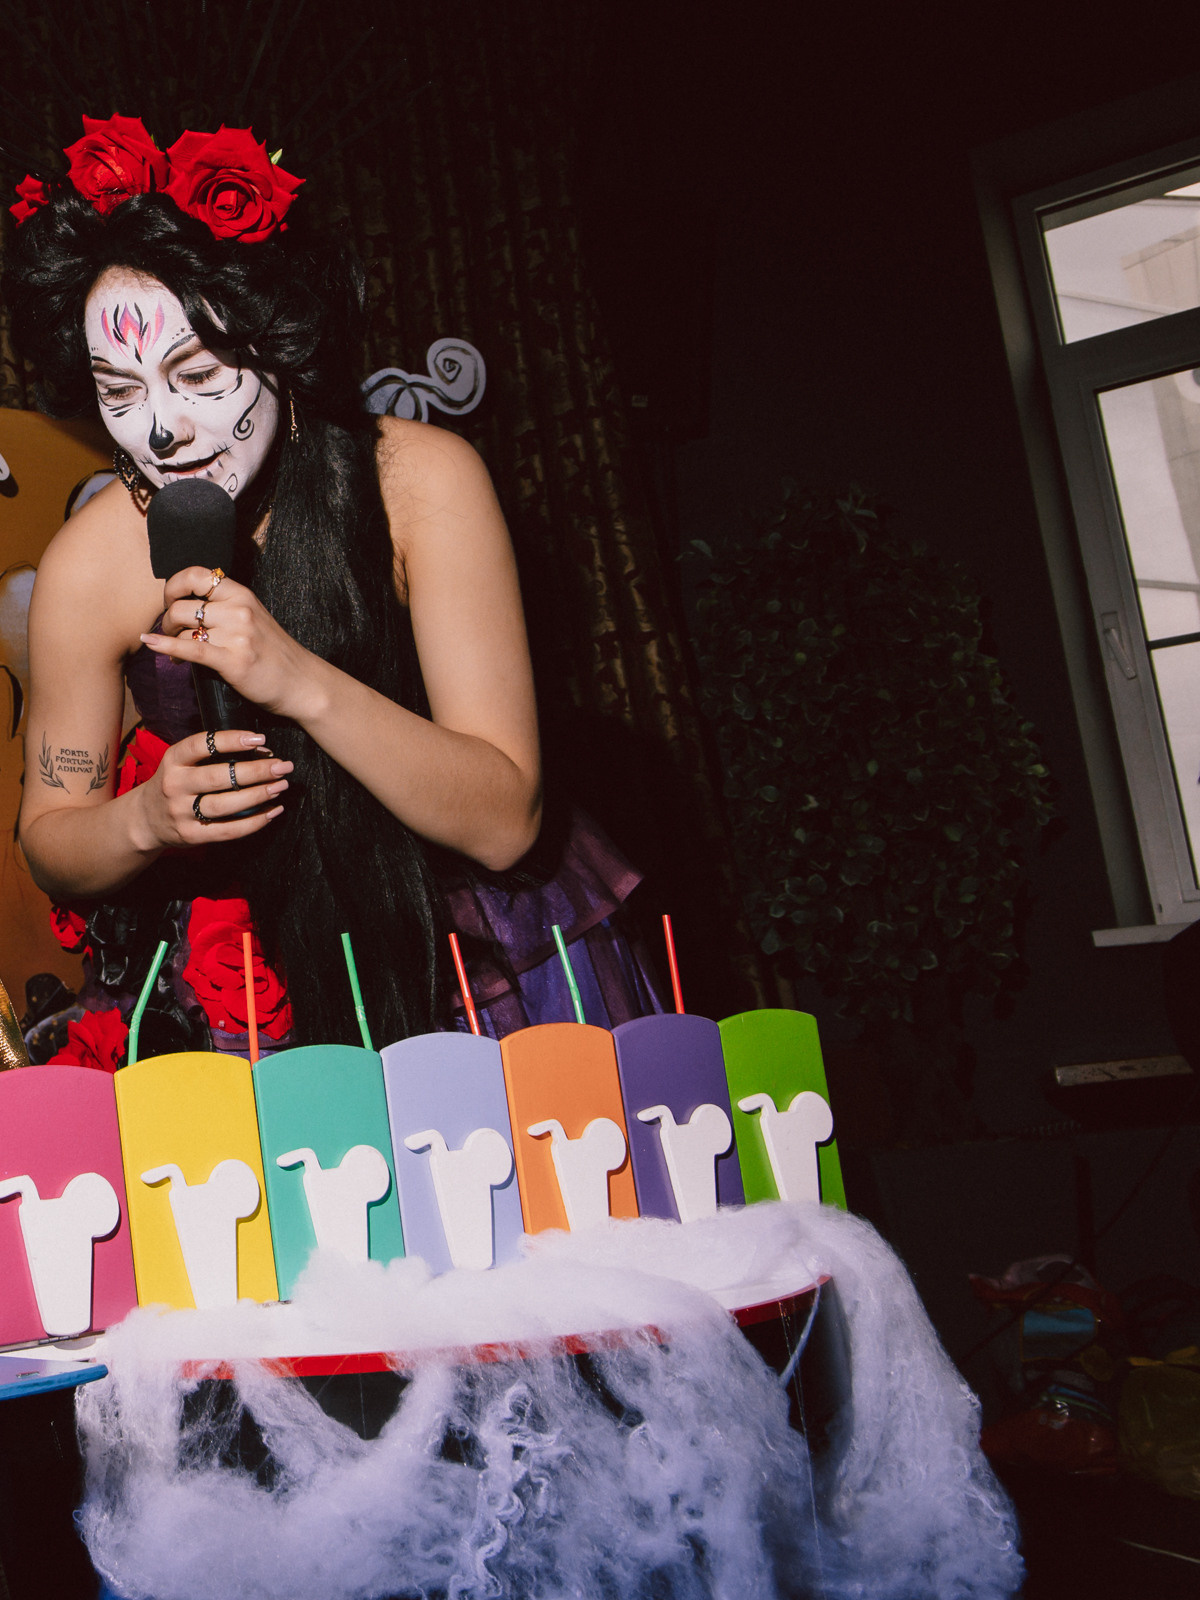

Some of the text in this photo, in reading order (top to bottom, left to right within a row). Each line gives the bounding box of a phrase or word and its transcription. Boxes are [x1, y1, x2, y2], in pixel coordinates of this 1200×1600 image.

[60, 748, 89, 758] FORTIS
[55, 755, 94, 765] FORTUNA
[57, 765, 93, 774] ADIUVAT
